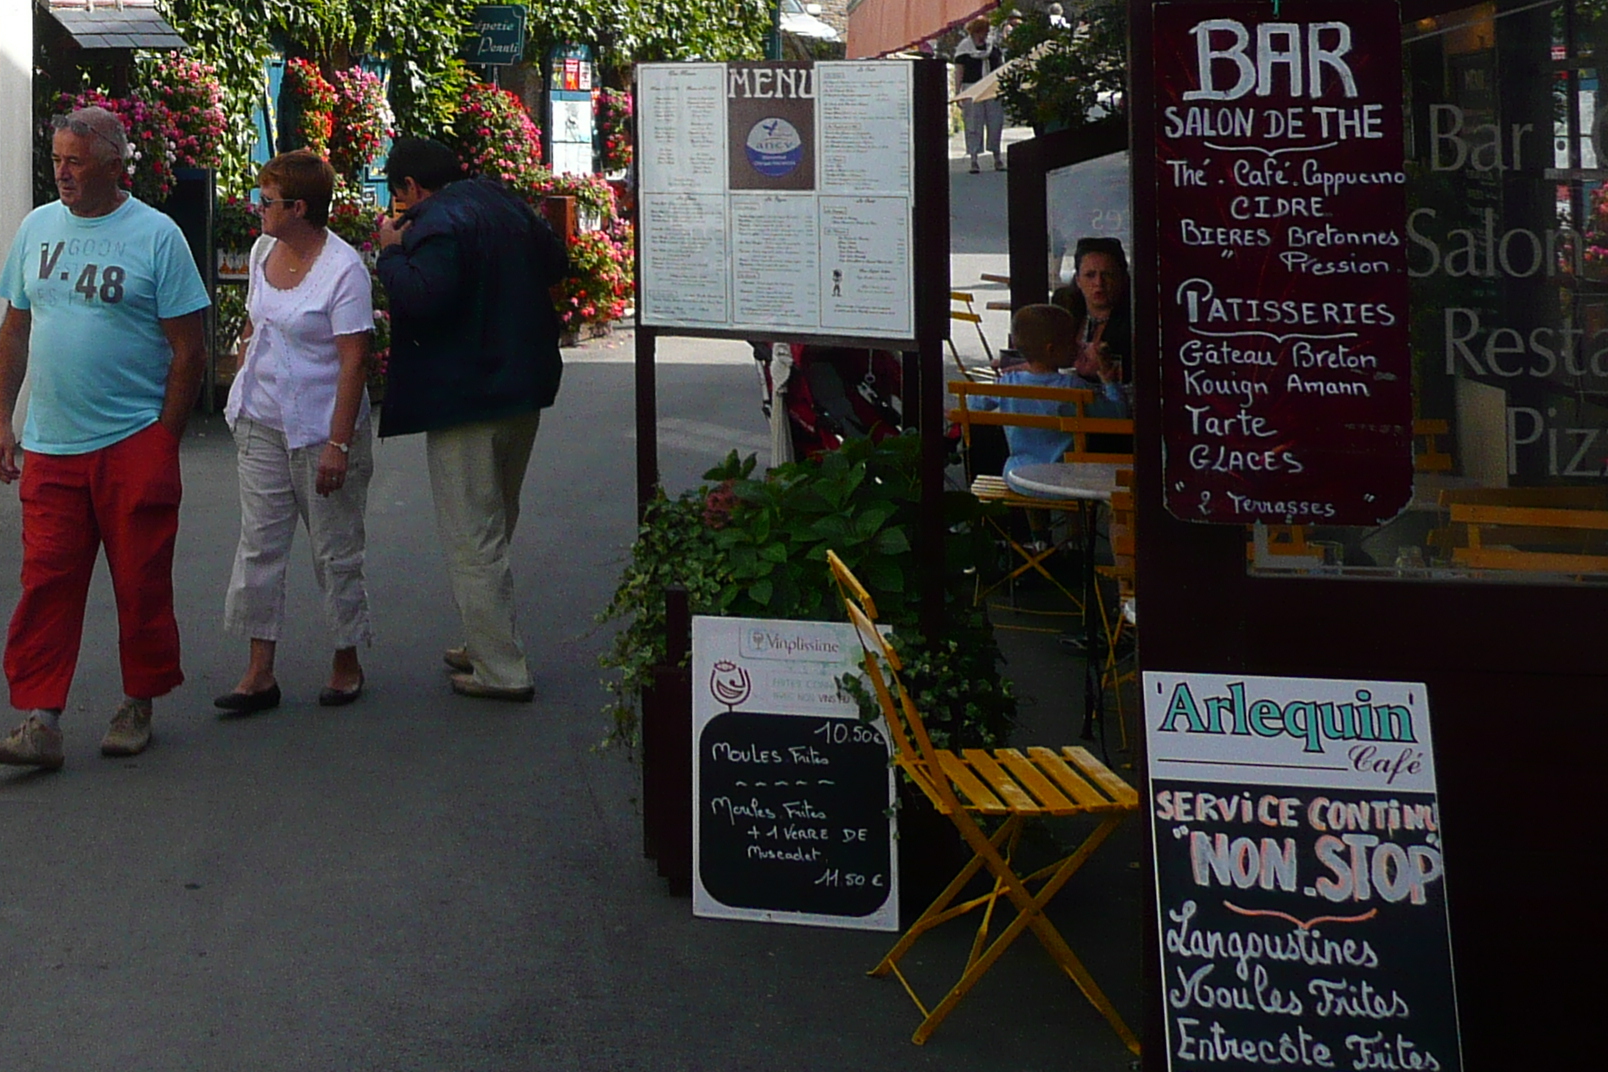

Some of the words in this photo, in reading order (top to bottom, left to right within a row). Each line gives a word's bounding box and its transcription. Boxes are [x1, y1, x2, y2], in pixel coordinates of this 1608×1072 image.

[1182, 18, 1359, 101] BAR
[728, 68, 814, 99] MENU
[1164, 106, 1254, 139] SALON
[1263, 107, 1306, 139] DE
[1311, 104, 1384, 140] THE
[1429, 104, 1534, 172] Bar
[1166, 158, 1211, 187] Thé
[1234, 157, 1291, 187] Café
[1302, 159, 1406, 197] Cappucino
[1231, 196, 1325, 219] CIDRE
[1181, 219, 1271, 246] BIERES
[1288, 224, 1399, 248] Bretonnes
[1405, 207, 1584, 278] Salon
[1279, 251, 1390, 276] Pression
[1177, 278, 1396, 326] PATISSERIES
[1179, 340, 1278, 366] Gâteau
[1291, 342, 1377, 368] Breton
[1184, 369, 1269, 408] Kouign
[1287, 374, 1371, 397] Amann
[1184, 404, 1278, 436] Tarte
[1189, 444, 1304, 473] GLACES
[1507, 406, 1608, 477] Piz
[1226, 491, 1336, 517] Terrasses
[788, 745, 830, 765] Frites
[1347, 743, 1424, 785] Café
[782, 799, 827, 819] Frites
[842, 829, 867, 843] DE
[1167, 900, 1378, 980] Langoustines
[1308, 979, 1410, 1018] Frites
[1176, 1017, 1335, 1067] Entrecôte
[1345, 1030, 1442, 1071] Frites
